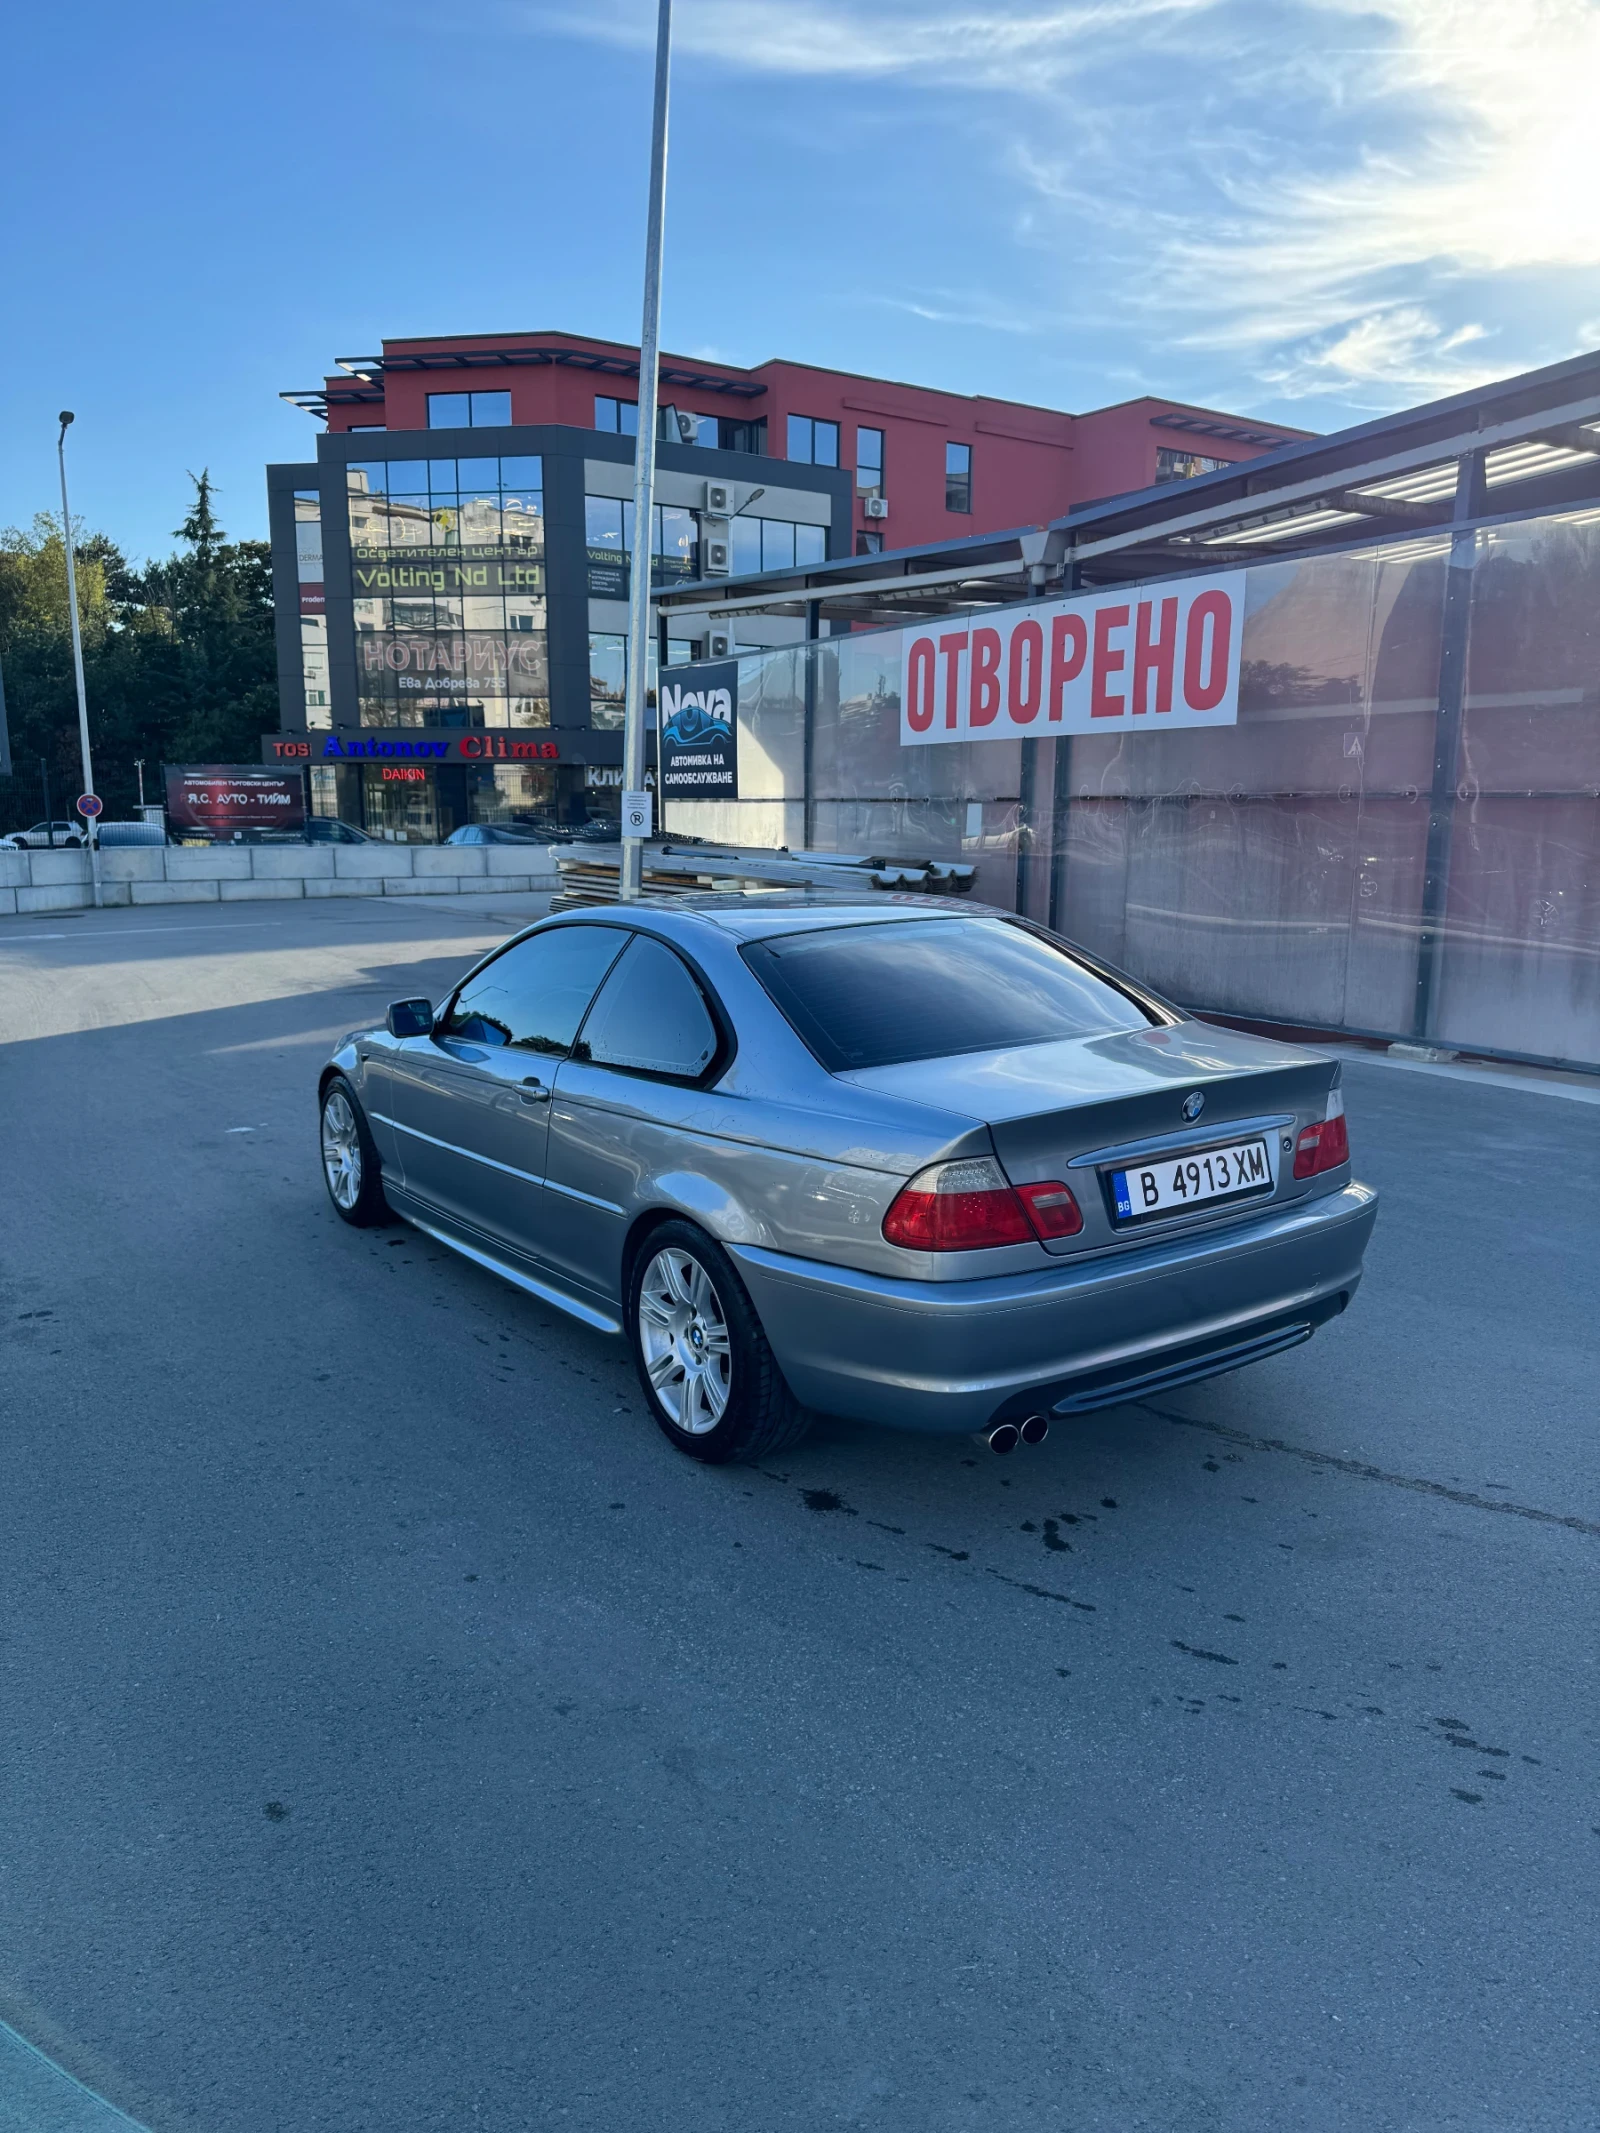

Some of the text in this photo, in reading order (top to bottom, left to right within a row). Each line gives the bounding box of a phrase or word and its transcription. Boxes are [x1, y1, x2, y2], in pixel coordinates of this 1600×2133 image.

[356, 545, 538, 559] Осветителен център
[587, 550, 623, 565] Volting
[356, 564, 541, 592] Volting Nd Ltd
[363, 639, 542, 671] НОТАРИУС
[906, 589, 1233, 733] ОТВОРЕНО
[398, 677, 507, 691] Ева Добрева 755
[661, 683, 732, 730] Nova
[322, 735, 560, 759] Antonov Clima
[670, 753, 725, 767] АВТОМИВКА НА
[382, 768, 426, 781] DAIKIN
[664, 771, 733, 785] САМООБСЛУЖВАНЕ
[217, 793, 248, 804] АУТО
[257, 792, 291, 805] ТИЙМ
[1140, 1145, 1266, 1207] B 4913 XM
[1117, 1200, 1131, 1212] BG
